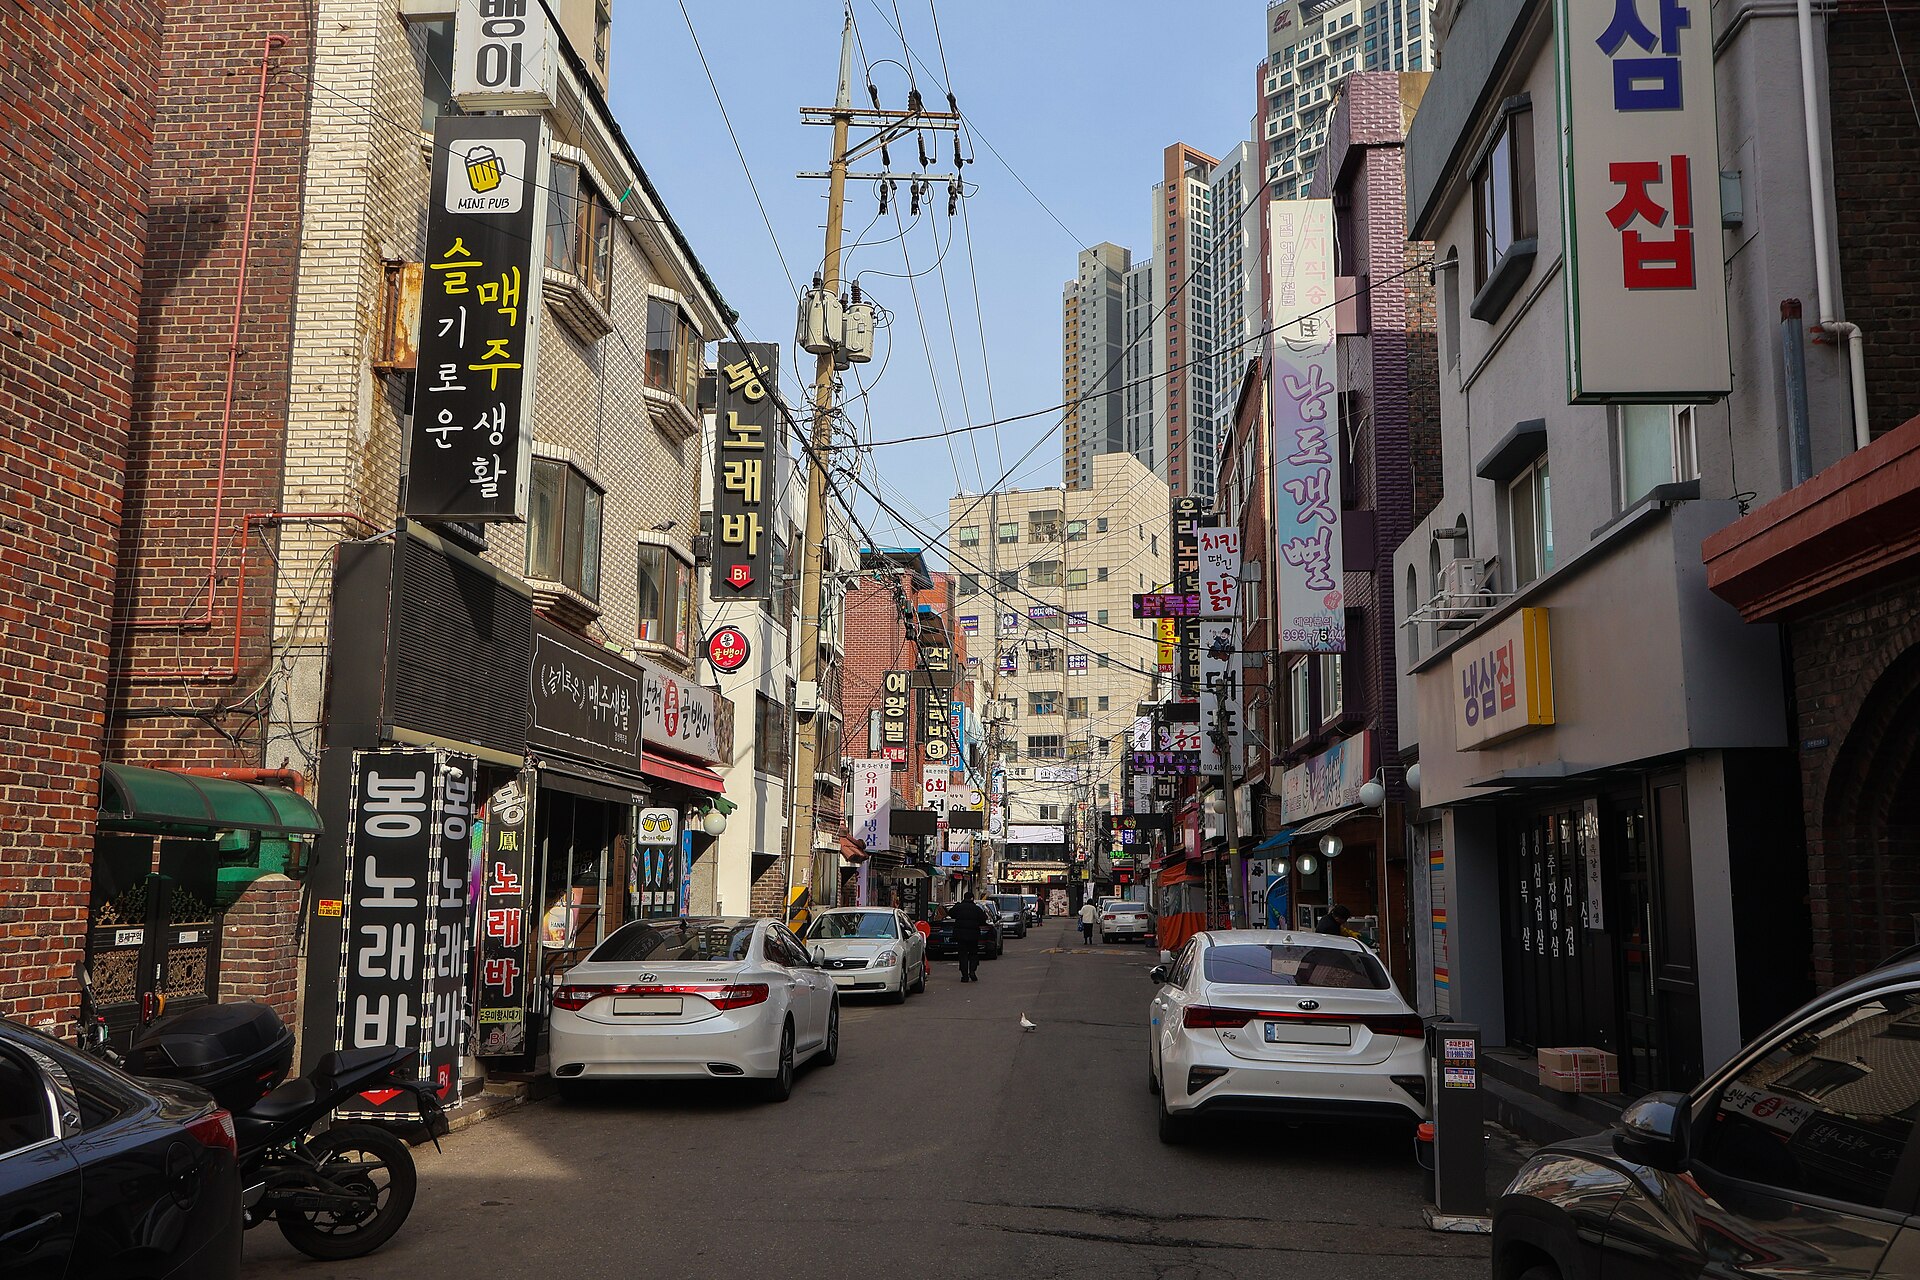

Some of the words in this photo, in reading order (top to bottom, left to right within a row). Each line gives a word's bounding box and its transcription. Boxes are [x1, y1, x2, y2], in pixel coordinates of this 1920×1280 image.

[458, 198, 485, 210] MINI
[487, 198, 510, 210] PUB
[1304, 213, 1327, 304] 산지직송
[425, 237, 482, 449] 슬기로운
[468, 266, 521, 499] 맥주생활
[1281, 363, 1339, 591] 남도갯벌
[1201, 533, 1238, 553] 치킨
[733, 568, 748, 581] B1
[1206, 579, 1233, 611] 닭
[1283, 629, 1343, 641] 393-7544
[1293, 617, 1332, 627] 예약문의
[713, 648, 743, 660] 골뱅이
[548, 663, 581, 702] 슬기로운
[588, 675, 630, 731] 맥주생활
[1462, 638, 1516, 727] 냉삼집
[681, 689, 711, 740] 골뱅이
[885, 674, 907, 742] 여왕벌
[931, 745, 944, 755] B1
[925, 778, 947, 793] 6회
[498, 830, 518, 852] 鳳
[865, 818, 878, 847] 냉삼
[353, 770, 427, 1049] 봉노래바
[434, 776, 469, 1047] 봉노래바
[484, 862, 521, 997] 노래바
[1301, 1000, 1315, 1008] KIA
[489, 1033, 508, 1045] B1
